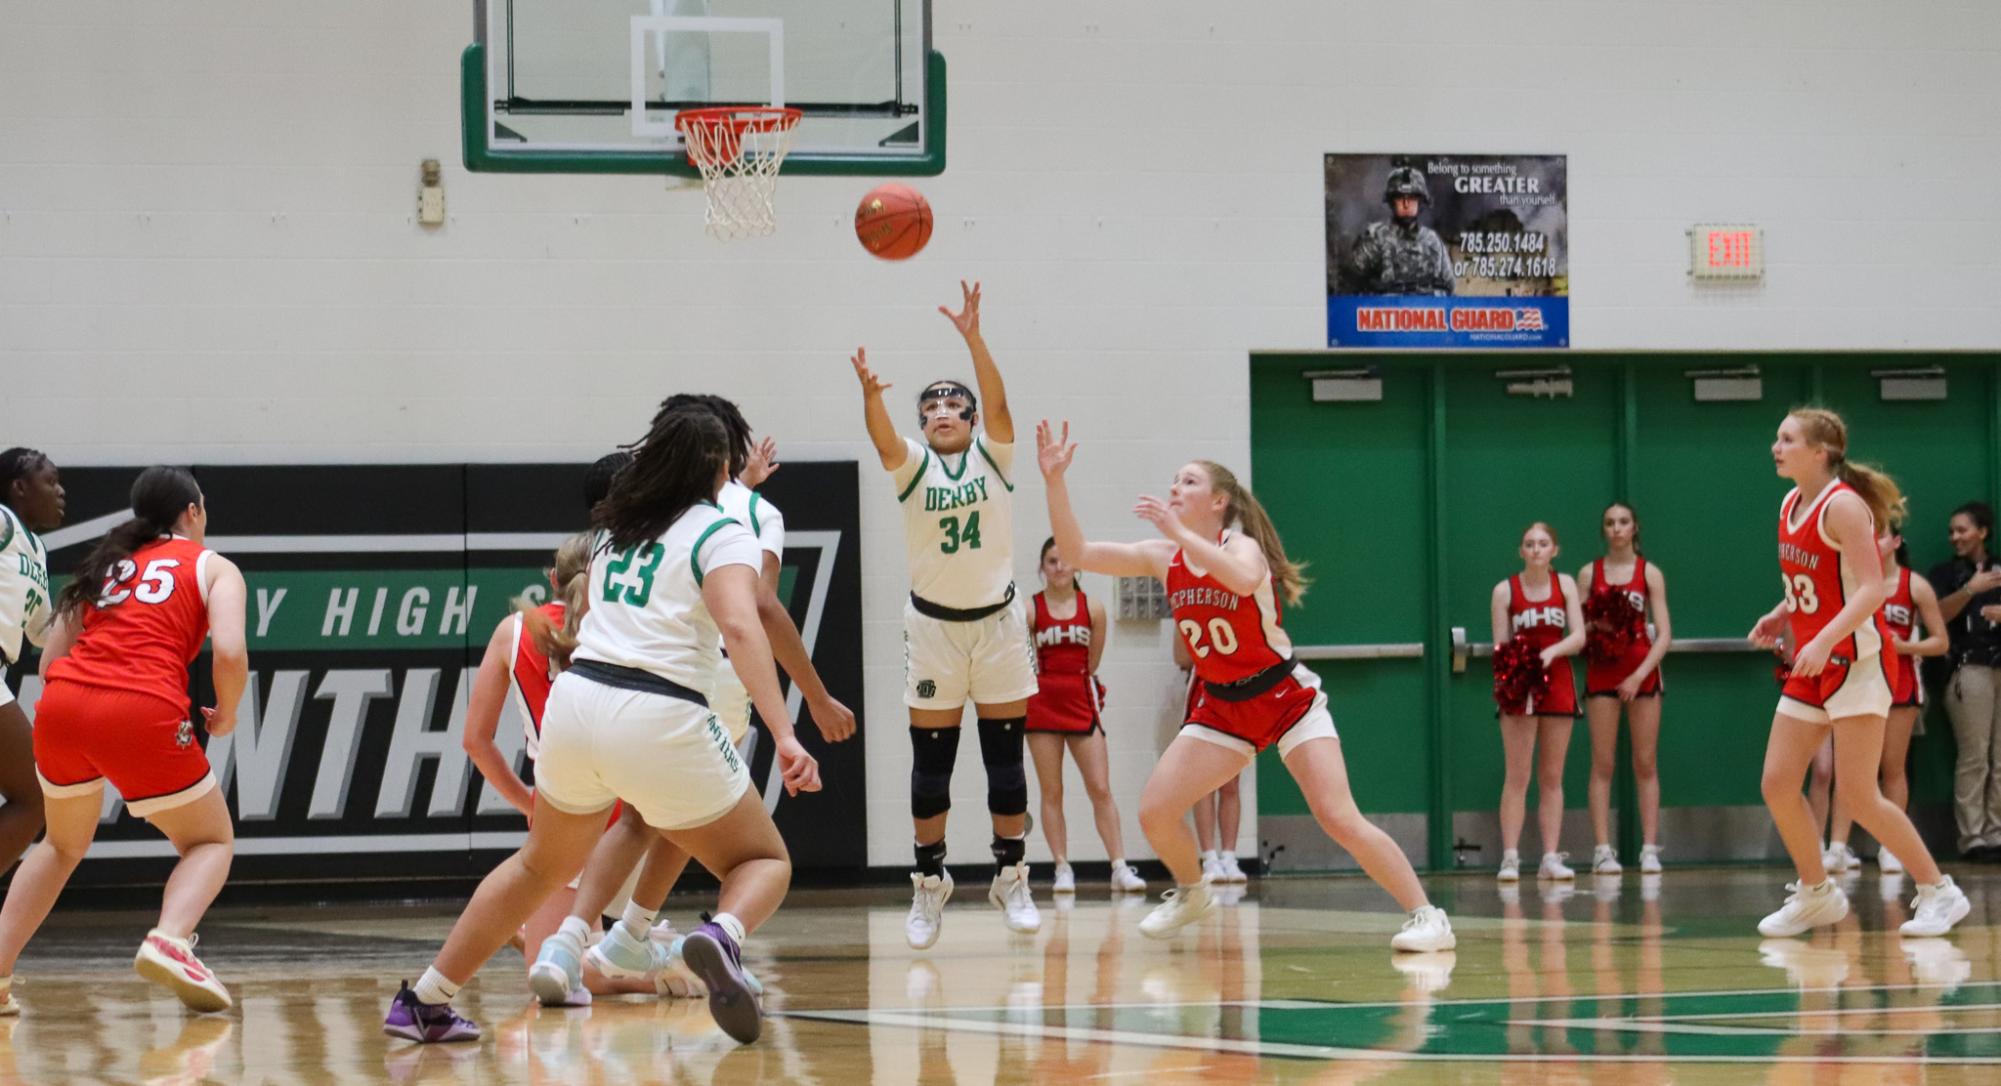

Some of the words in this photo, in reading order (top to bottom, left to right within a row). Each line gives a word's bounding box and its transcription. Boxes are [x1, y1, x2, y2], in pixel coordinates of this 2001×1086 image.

[1427, 162, 1458, 176] Belong
[1460, 163, 1470, 174] to
[1472, 162, 1517, 177] something
[1454, 176, 1539, 193] GREATER
[1500, 193, 1520, 205] than
[1460, 232, 1544, 253] 785.250.1484
[1708, 230, 1753, 268] EXIT
[1454, 261, 1469, 277] or
[1472, 256, 1556, 277] 785.274.1618
[1357, 307, 1449, 332] NATIONAL
[1450, 307, 1515, 332] GUARD
[925, 476, 988, 512] DERBY
[939, 510, 982, 554] 34
[97, 559, 180, 608] 25
[602, 541, 666, 608] 23
[320, 585, 478, 637] HIGH
[1512, 606, 1565, 632] MHS
[1036, 625, 1091, 648] MHS
[1178, 617, 1239, 659] 20
